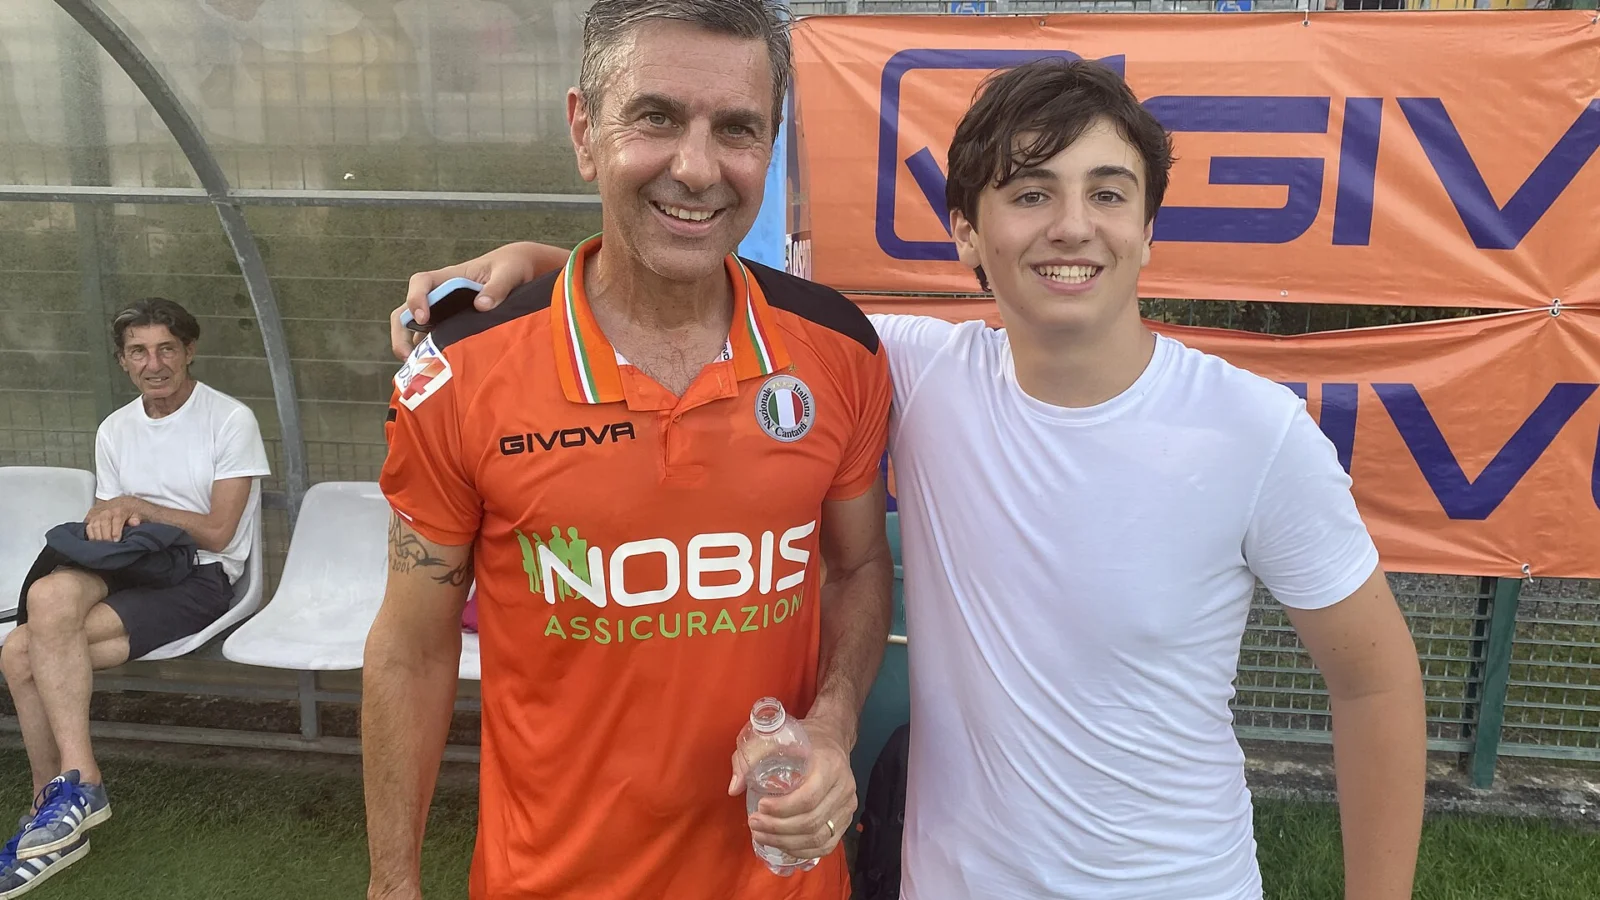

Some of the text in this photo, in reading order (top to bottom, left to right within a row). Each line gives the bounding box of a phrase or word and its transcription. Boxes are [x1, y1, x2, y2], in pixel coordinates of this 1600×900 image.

[759, 384, 810, 438] Nazionale Italiana Cantanti
[500, 421, 636, 456] GIVOVA
[537, 519, 816, 608] NOBIS
